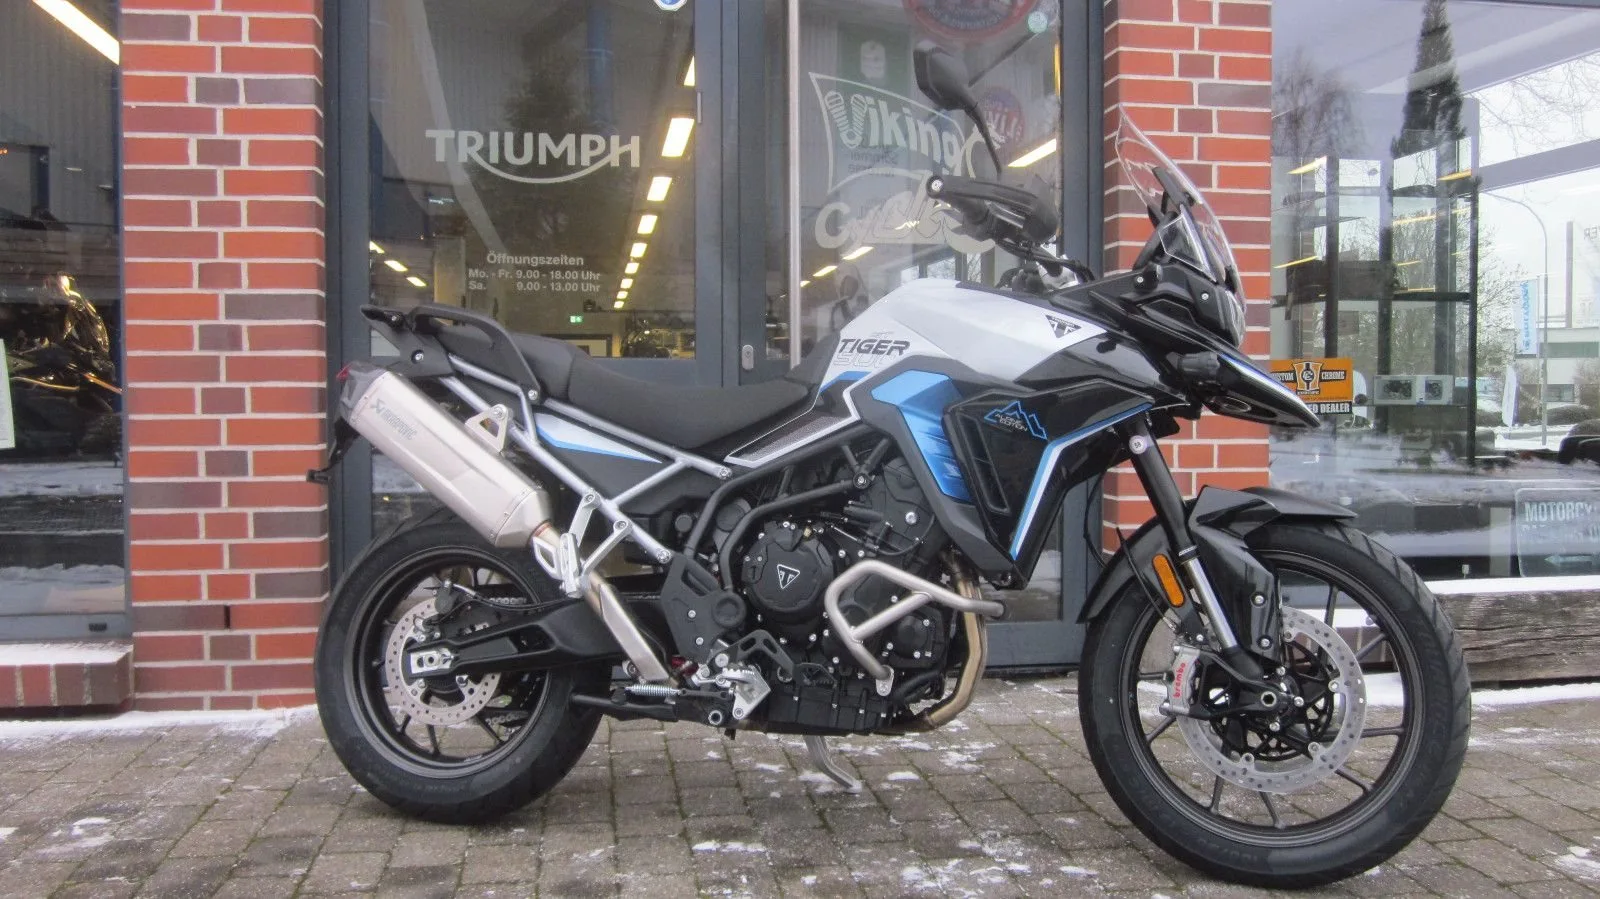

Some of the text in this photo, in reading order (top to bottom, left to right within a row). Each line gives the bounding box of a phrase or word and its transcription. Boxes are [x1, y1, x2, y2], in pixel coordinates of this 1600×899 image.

[425, 130, 640, 183] TRIUMPH
[487, 251, 584, 266] Öffnungszeiten
[469, 269, 489, 279] Mo.
[499, 269, 513, 279] Fr.
[516, 270, 540, 280] 9.00
[550, 270, 578, 280] 18.00
[581, 270, 601, 281] Uhr
[469, 281, 487, 291] Sa.
[516, 282, 540, 292] 9.00
[550, 282, 578, 292] 13.00
[581, 282, 601, 293] Uhr
[840, 338, 911, 356] TIGER
[1321, 371, 1345, 381] CHROME
[1320, 403, 1350, 414] DEALER
[1174, 663, 1185, 697] brembo
